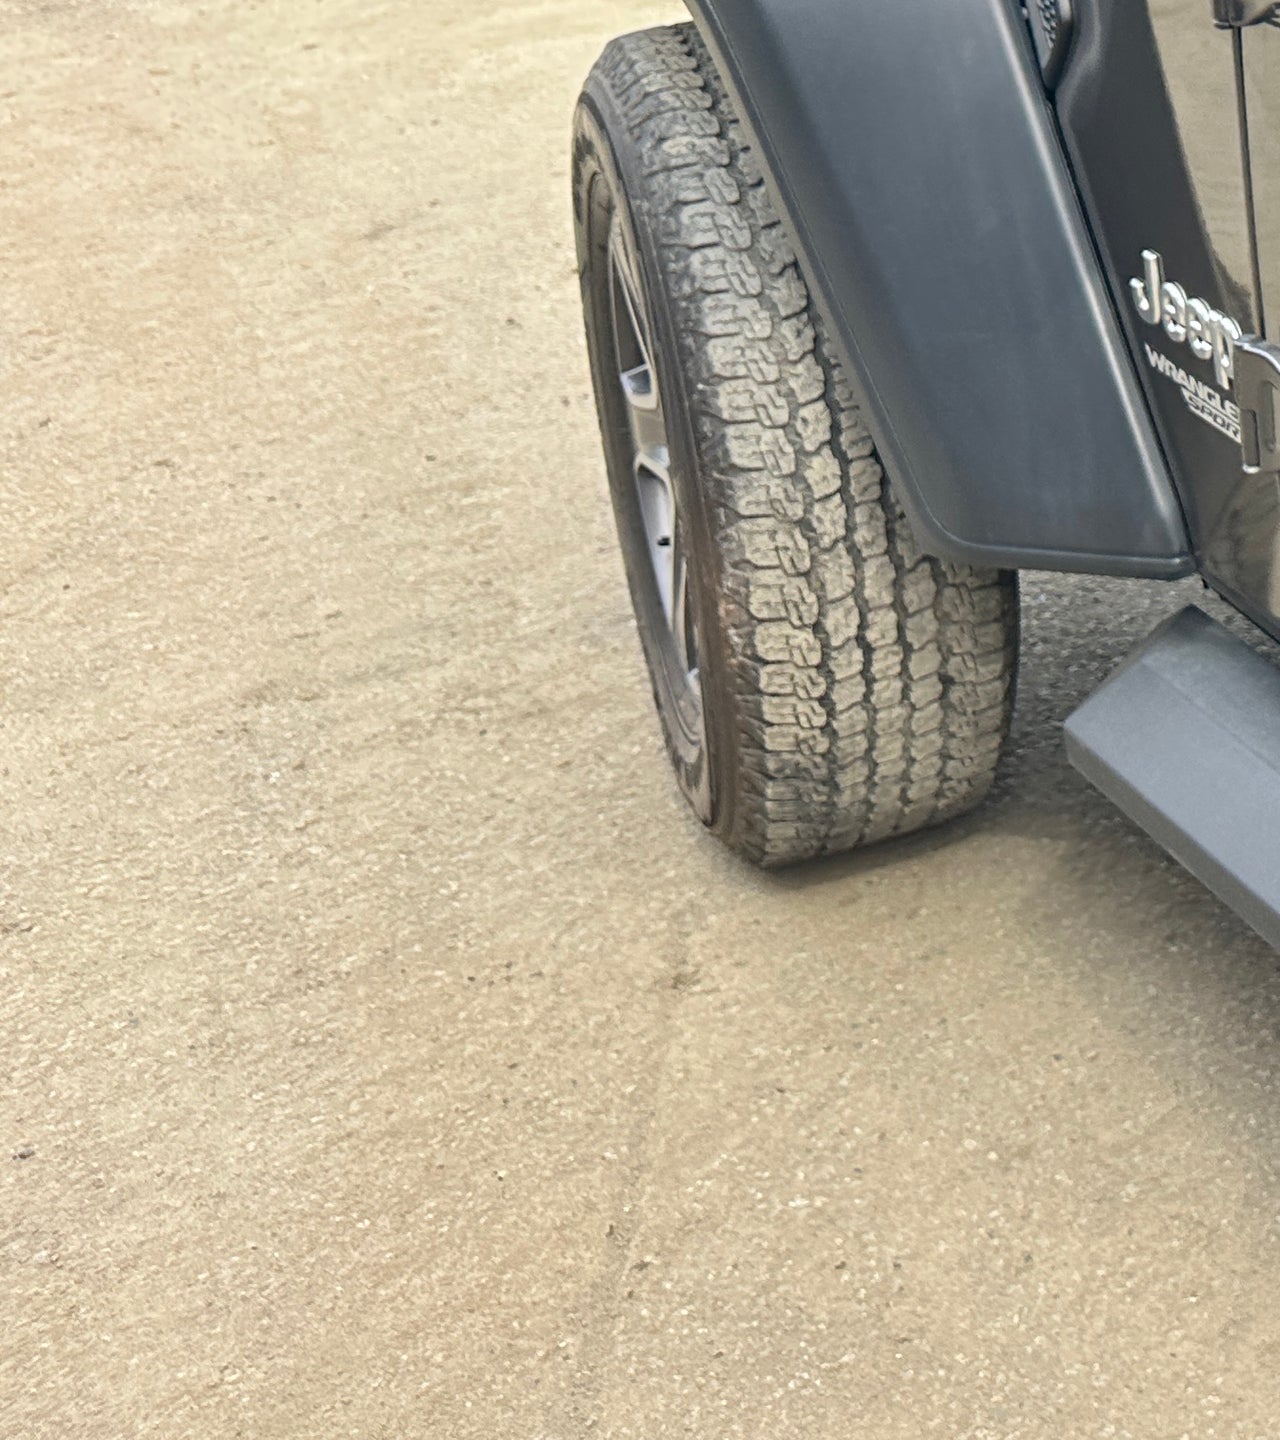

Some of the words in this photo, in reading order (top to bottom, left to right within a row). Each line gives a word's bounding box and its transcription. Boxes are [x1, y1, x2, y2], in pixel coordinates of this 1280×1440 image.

[1128, 247, 1243, 391] Jeep
[1144, 341, 1241, 422] WRANGLE
[1186, 394, 1242, 440] SPOR
